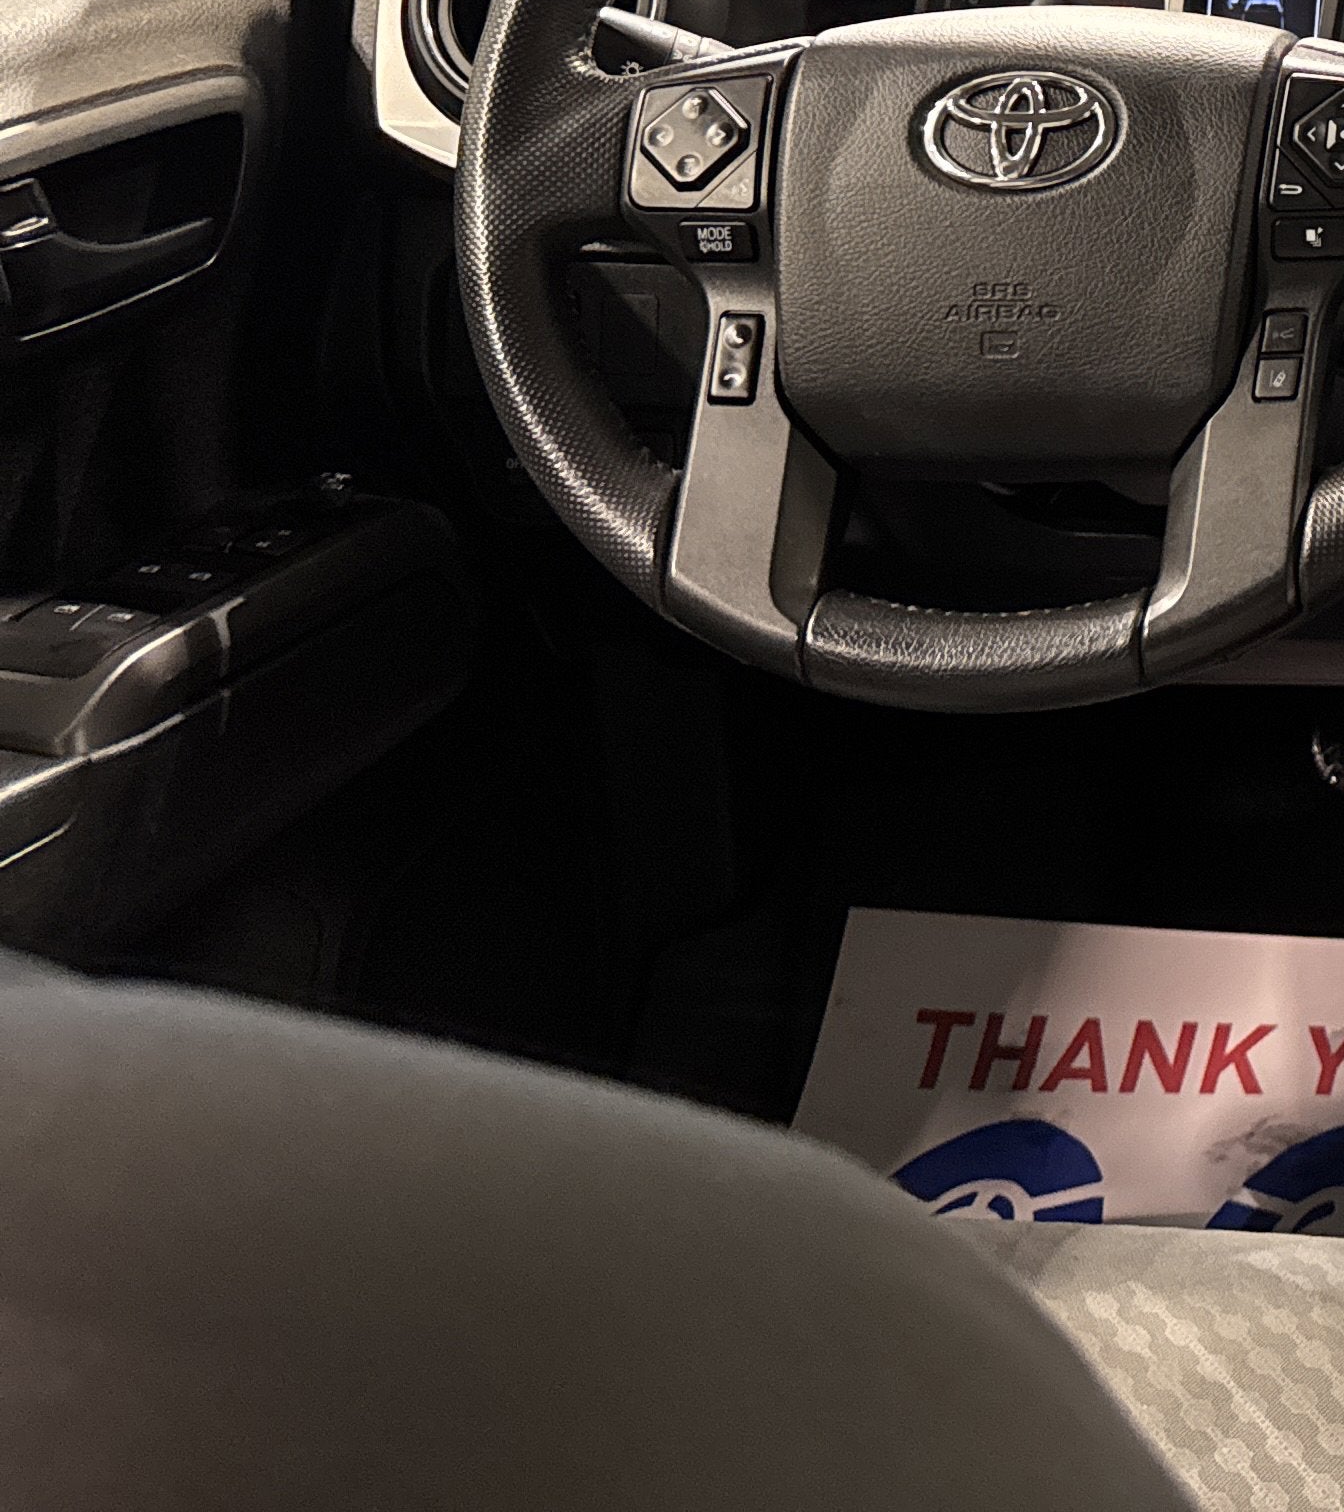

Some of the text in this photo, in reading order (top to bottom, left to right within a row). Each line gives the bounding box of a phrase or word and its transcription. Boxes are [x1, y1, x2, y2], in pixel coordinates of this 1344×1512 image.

[697, 226, 732, 240] MODE
[708, 241, 732, 252] HOLD
[945, 304, 1060, 321] AIRBAG
[916, 1011, 1278, 1094] THANK
